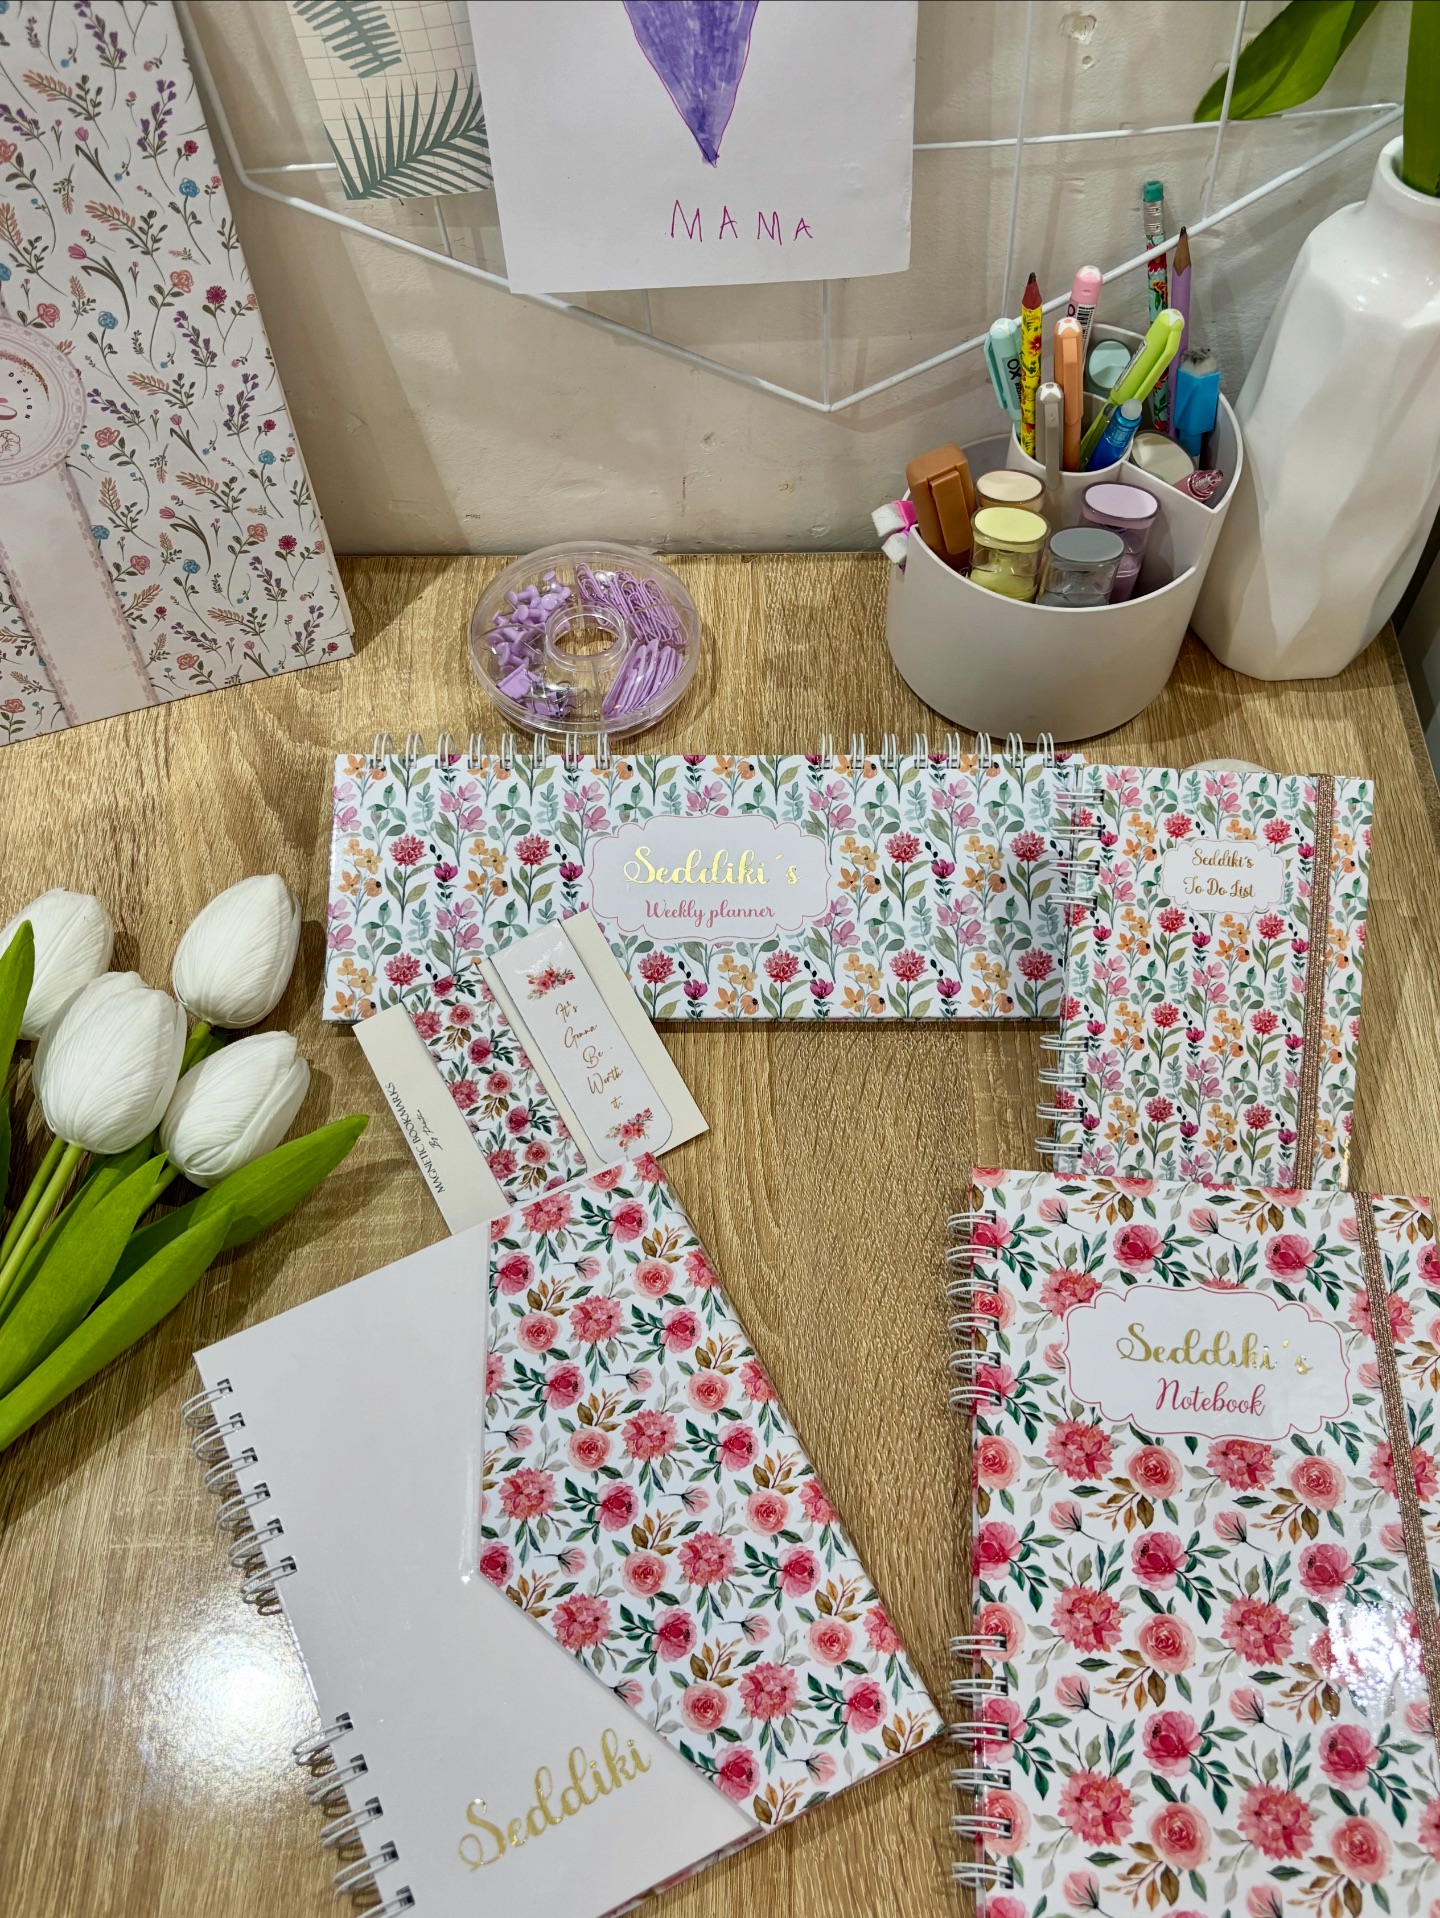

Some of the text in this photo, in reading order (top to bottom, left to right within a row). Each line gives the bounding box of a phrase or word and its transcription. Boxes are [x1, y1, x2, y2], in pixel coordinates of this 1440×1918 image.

[670, 199, 814, 246] MAMA
[8, 371, 33, 420] DESIGN
[1192, 848, 1255, 869] Seddiki's
[1183, 875, 1256, 898] To Do List
[645, 899, 775, 929] Weekly planner
[555, 1001, 579, 1023] It's
[564, 1024, 598, 1049] Gonna
[582, 1045, 604, 1069] Be
[587, 1065, 624, 1095] Worth
[385, 1081, 446, 1194] MAGNETIC BOOKMARKS
[1155, 1377, 1266, 1417] Notebook
[458, 1727, 652, 1873] Seddiki
